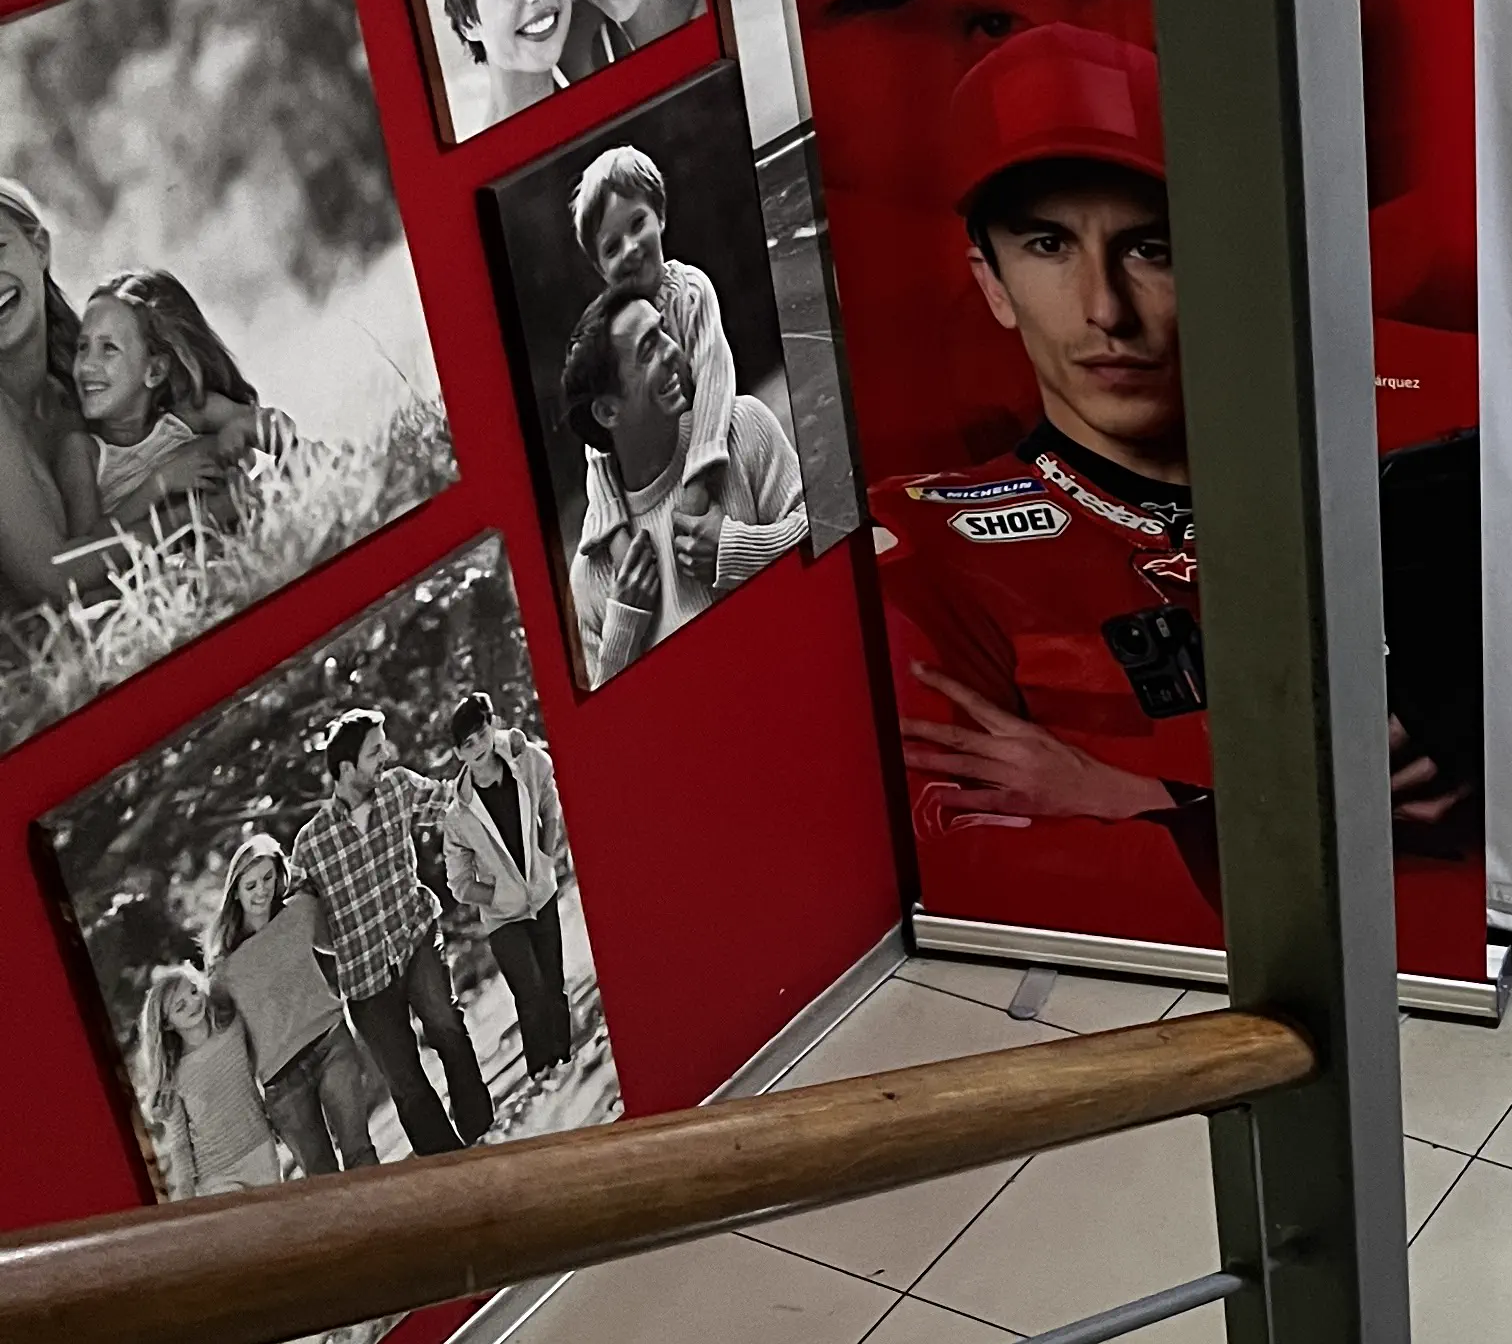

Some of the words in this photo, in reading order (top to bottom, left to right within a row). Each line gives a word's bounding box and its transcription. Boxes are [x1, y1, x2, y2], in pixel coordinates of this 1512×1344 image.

[946, 481, 1033, 499] MICHELIN
[1035, 453, 1165, 536] alpinestars
[965, 507, 1056, 536] SHOEI
